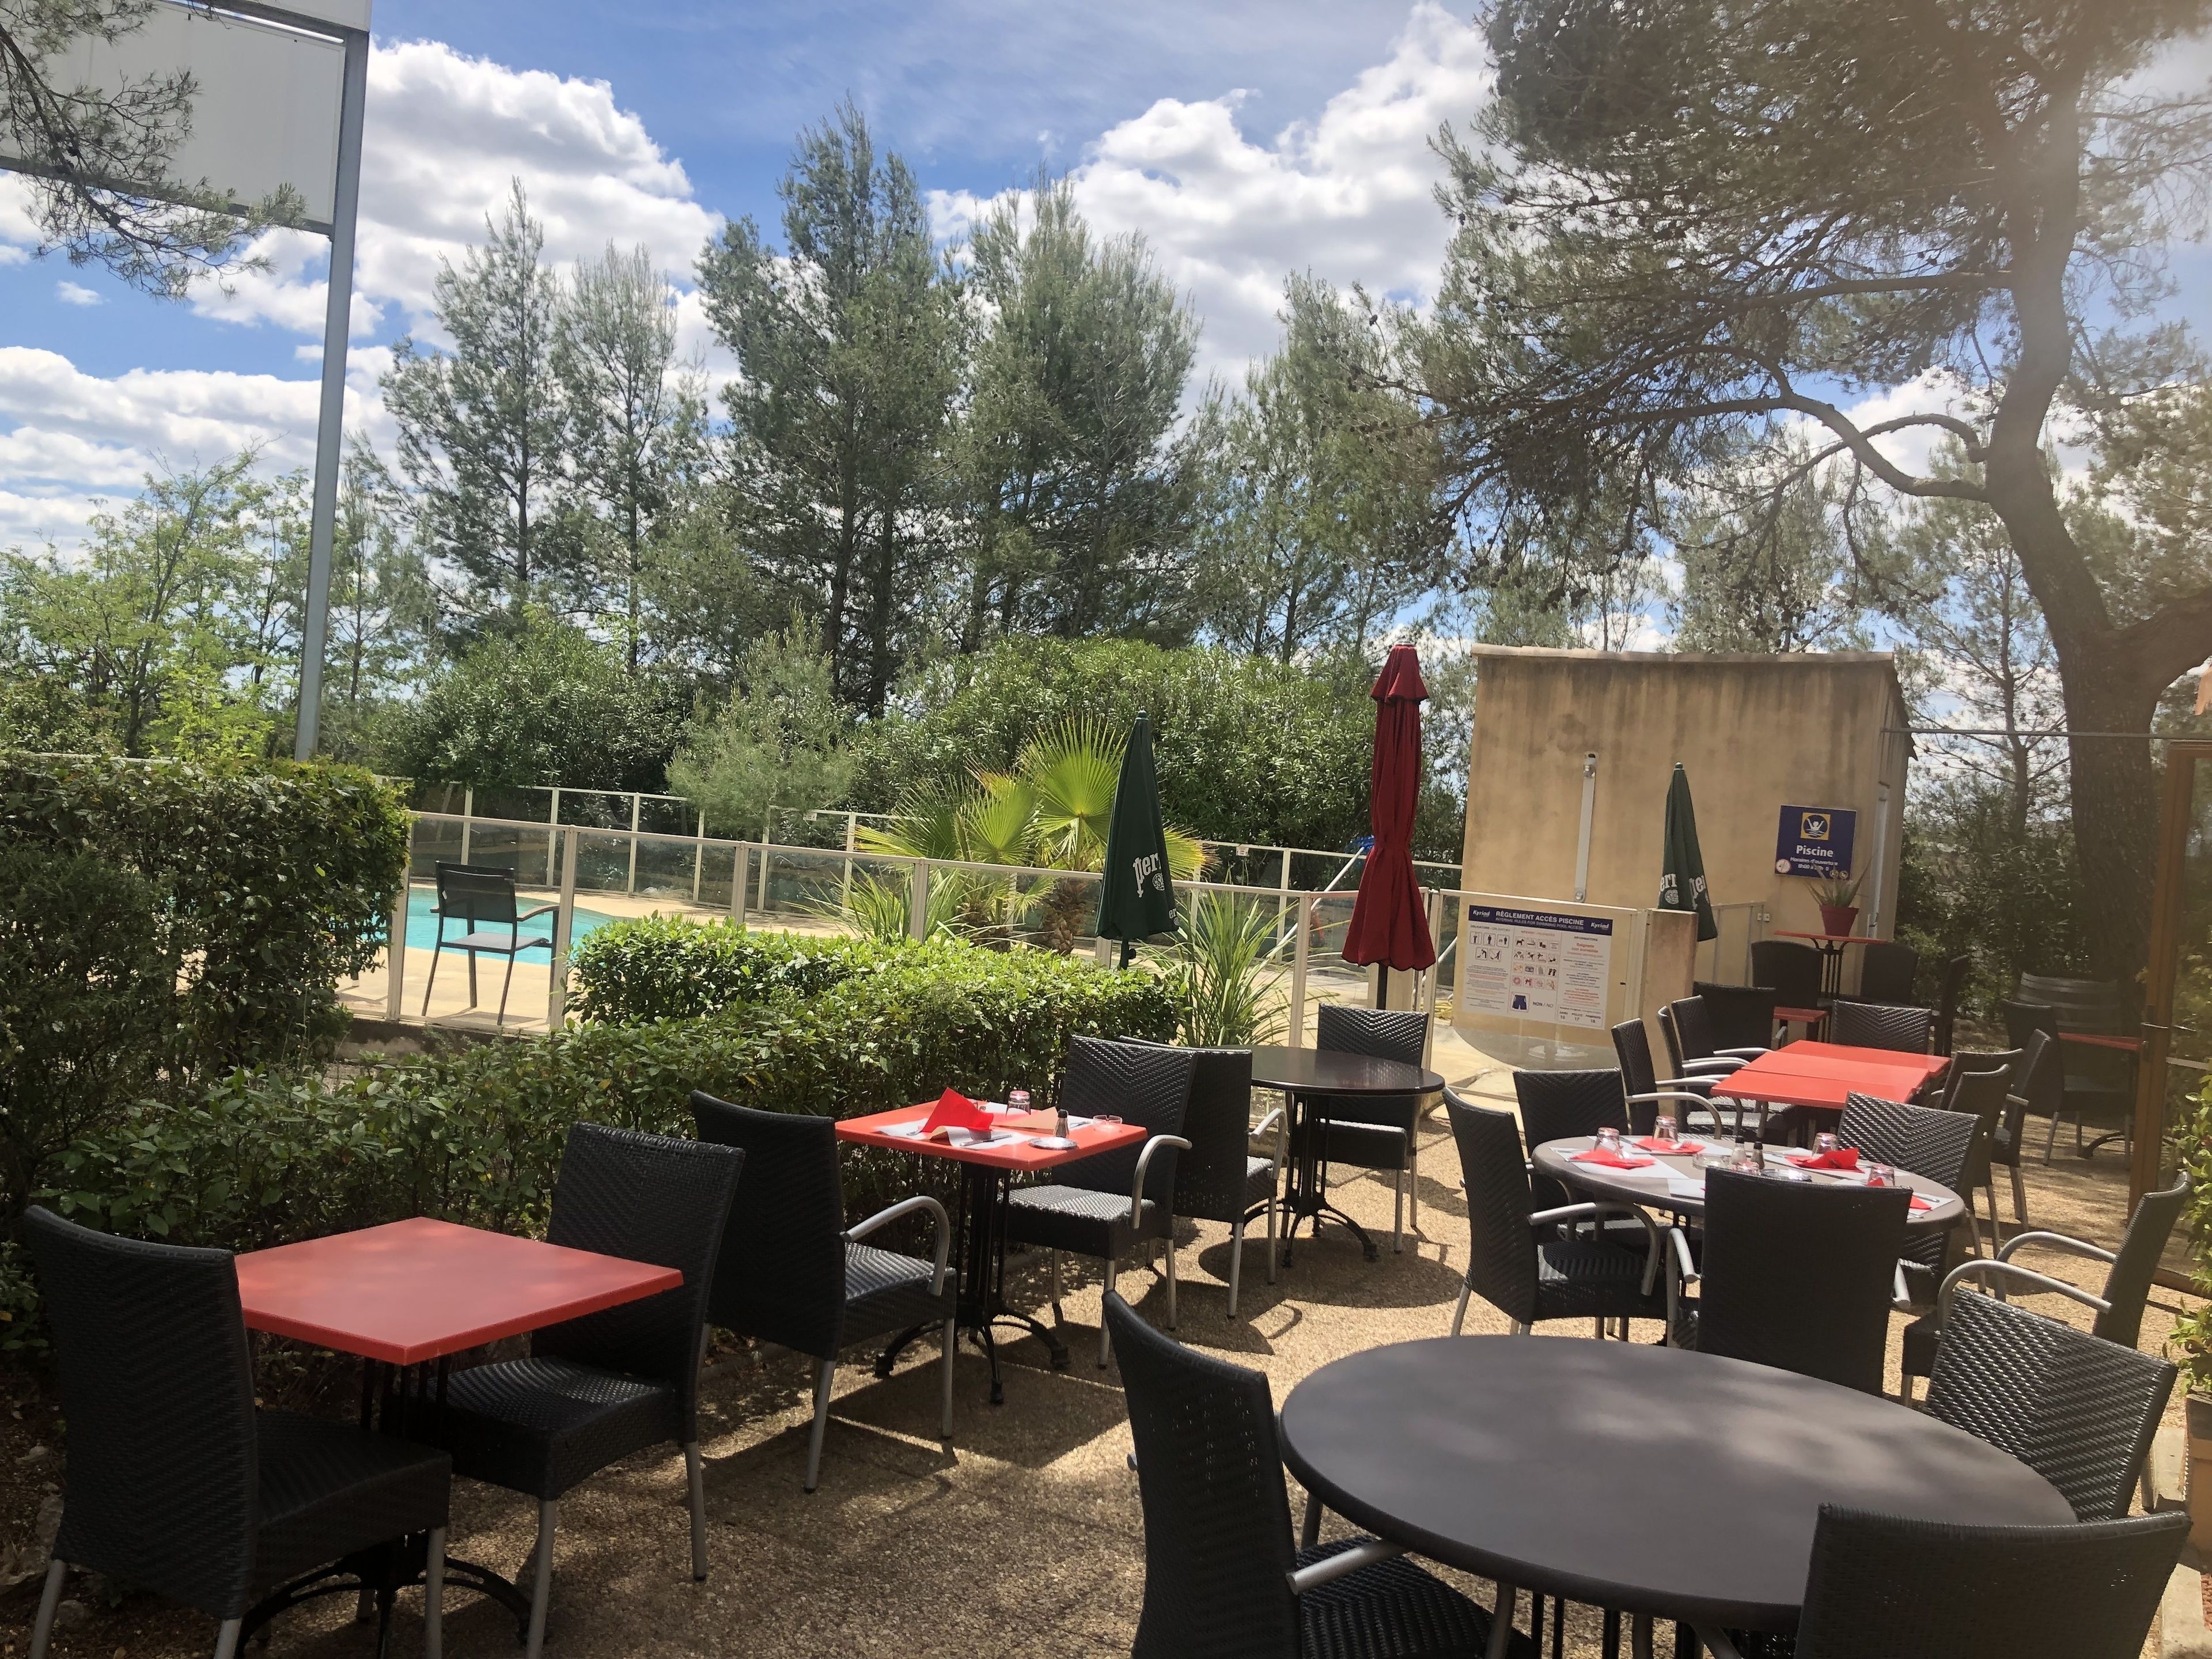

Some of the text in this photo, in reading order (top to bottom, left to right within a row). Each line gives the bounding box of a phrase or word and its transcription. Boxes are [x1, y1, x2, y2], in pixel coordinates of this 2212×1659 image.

[1796, 845, 1834, 857] Piscine
[1496, 911, 1584, 926] RÈGLEMENT ACCÈS PISCINE
